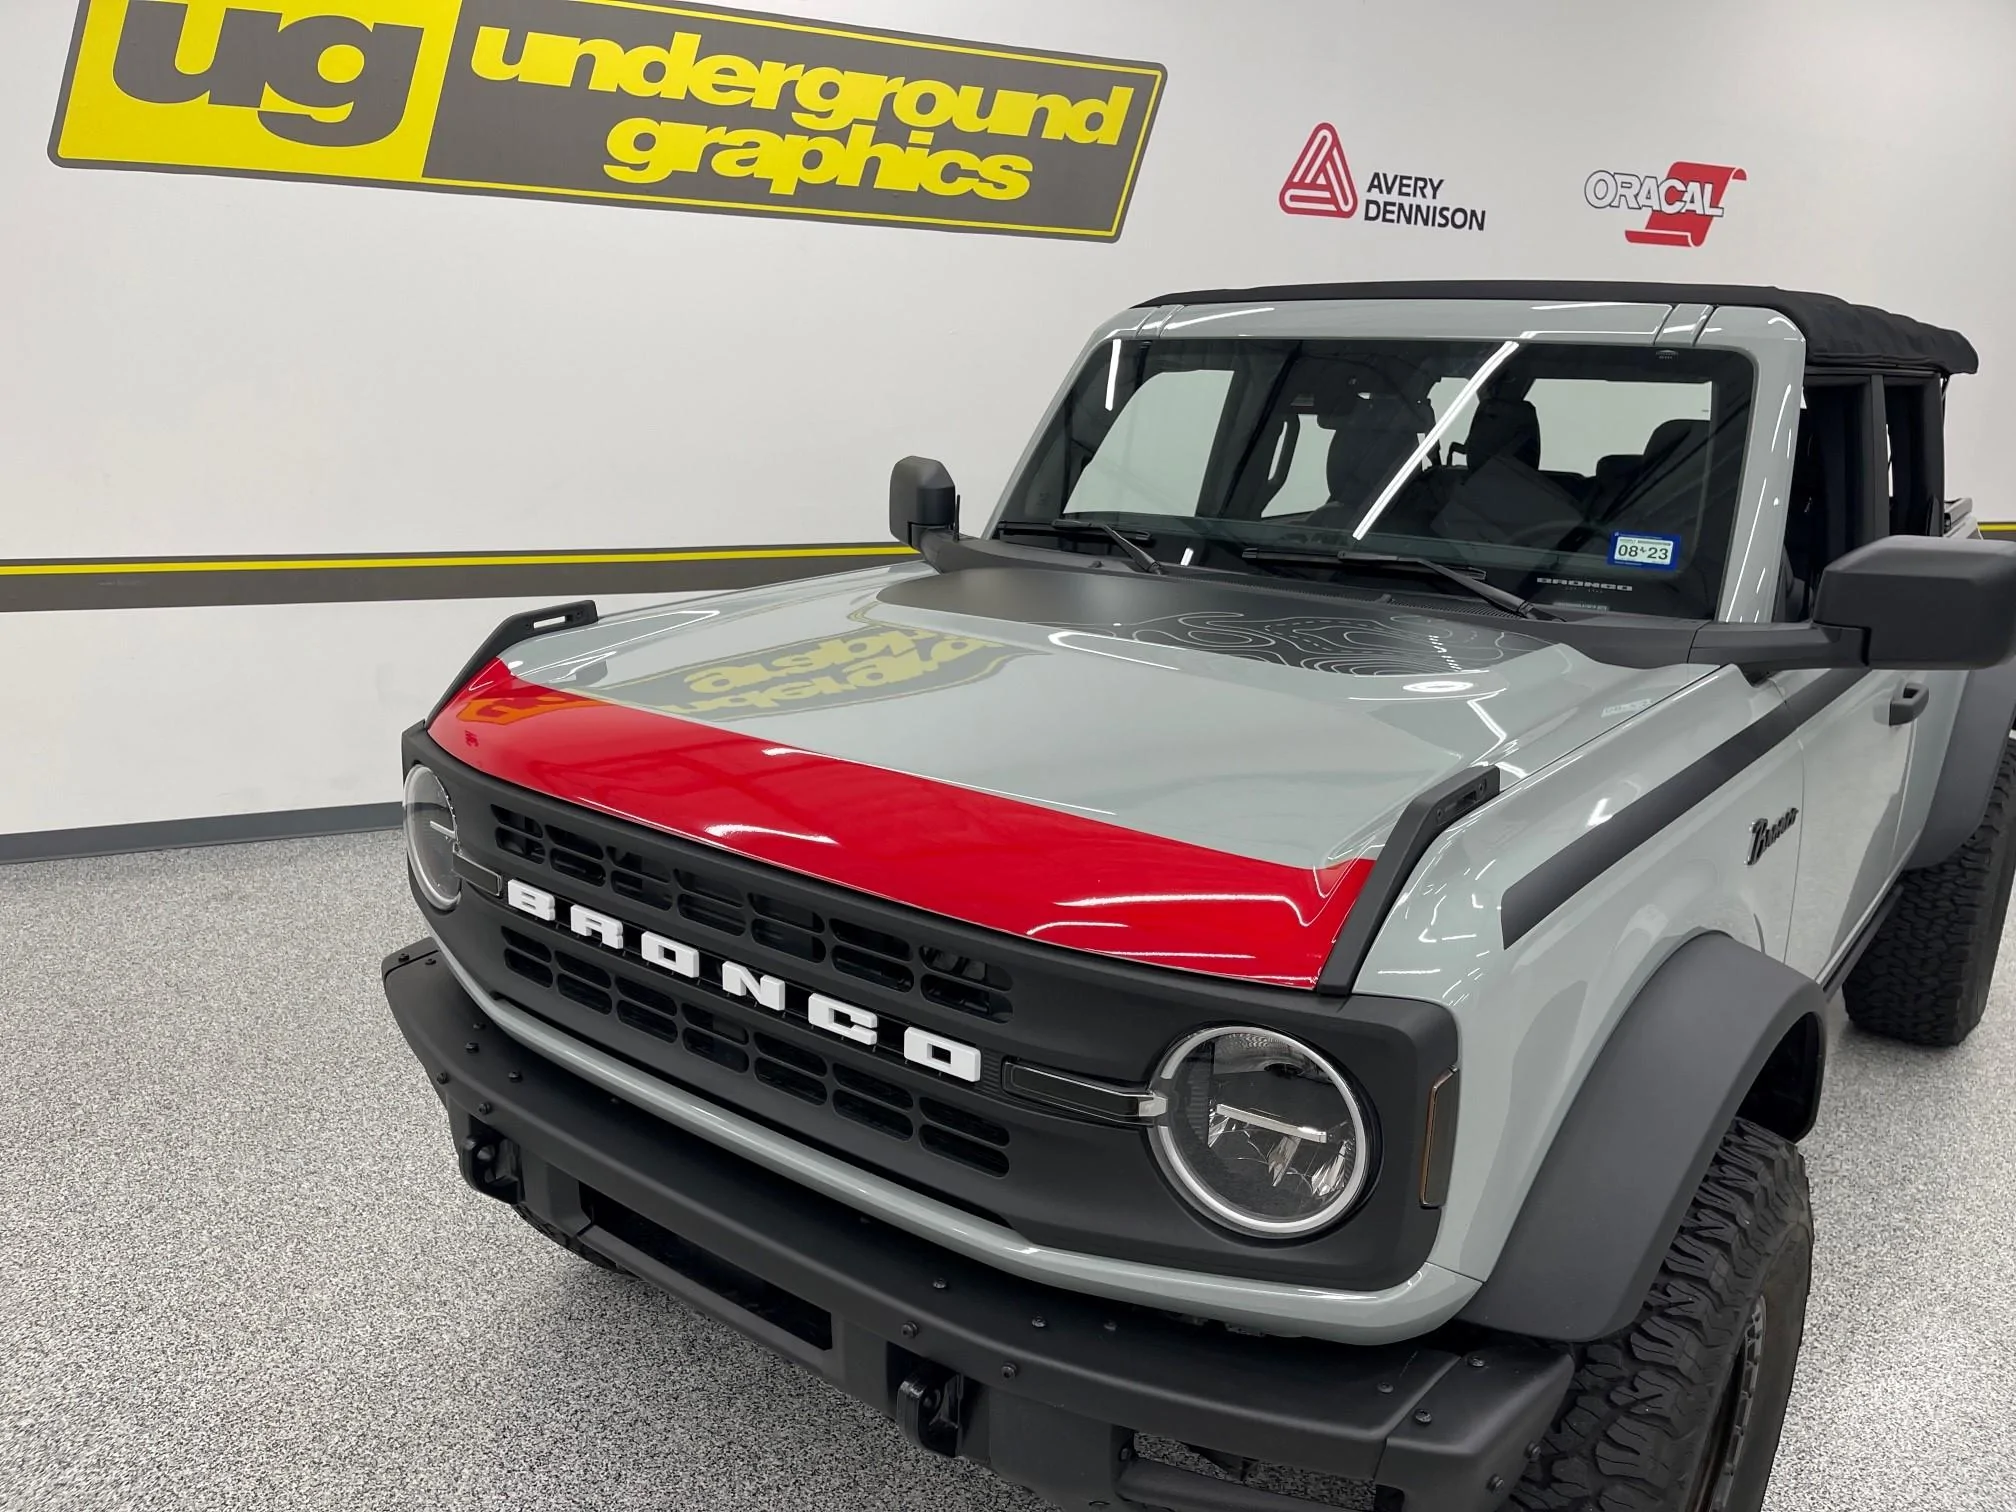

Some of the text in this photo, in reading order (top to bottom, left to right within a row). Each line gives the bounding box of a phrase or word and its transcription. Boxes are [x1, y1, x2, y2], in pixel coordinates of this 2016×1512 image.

[113, 0, 424, 147] ug
[471, 26, 1134, 145] underground
[604, 118, 1033, 200] graphics
[1367, 172, 1444, 200] AVERY
[1584, 170, 1723, 217] ORACAL
[1364, 200, 1486, 231] DENNISON
[508, 879, 981, 1082] BRONCO
